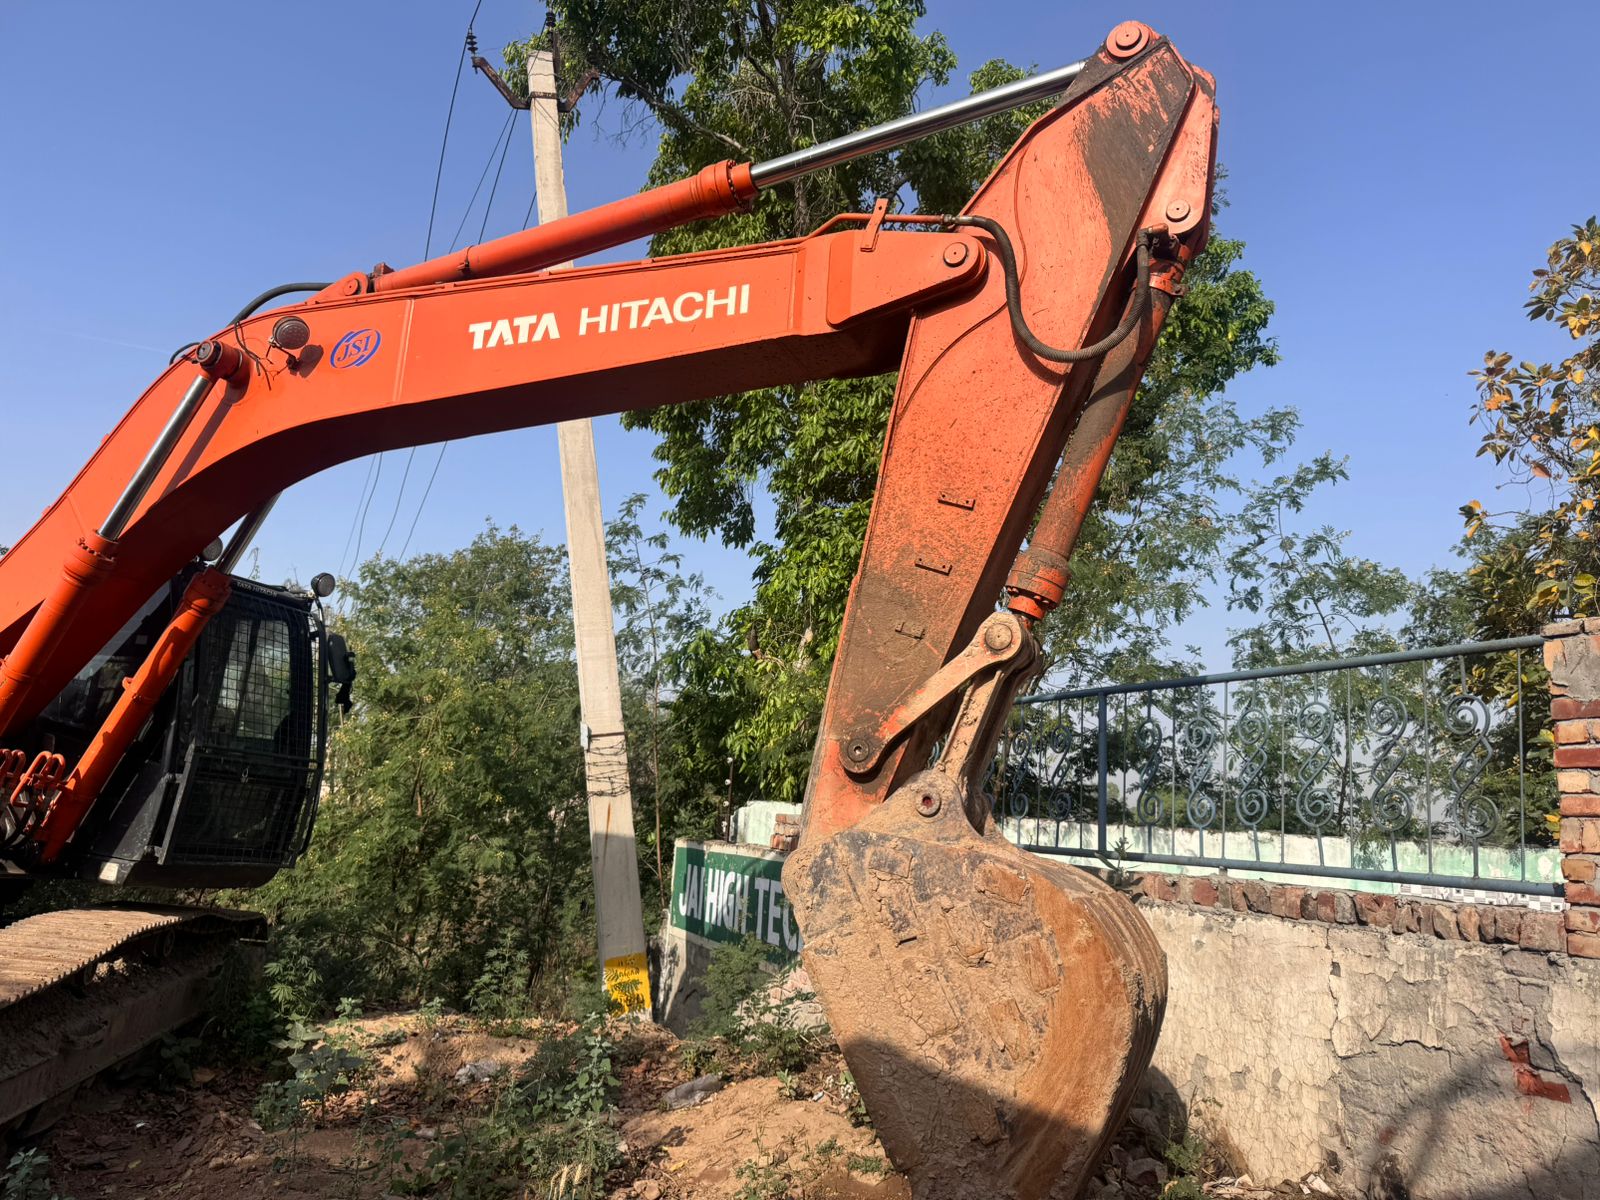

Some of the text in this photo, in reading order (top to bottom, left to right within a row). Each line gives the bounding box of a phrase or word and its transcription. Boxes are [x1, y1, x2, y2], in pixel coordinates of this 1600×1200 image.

[337, 335, 371, 362] JSI
[468, 284, 750, 350] TATA HITACHI
[679, 863, 805, 953] JAI HIGH TEC
